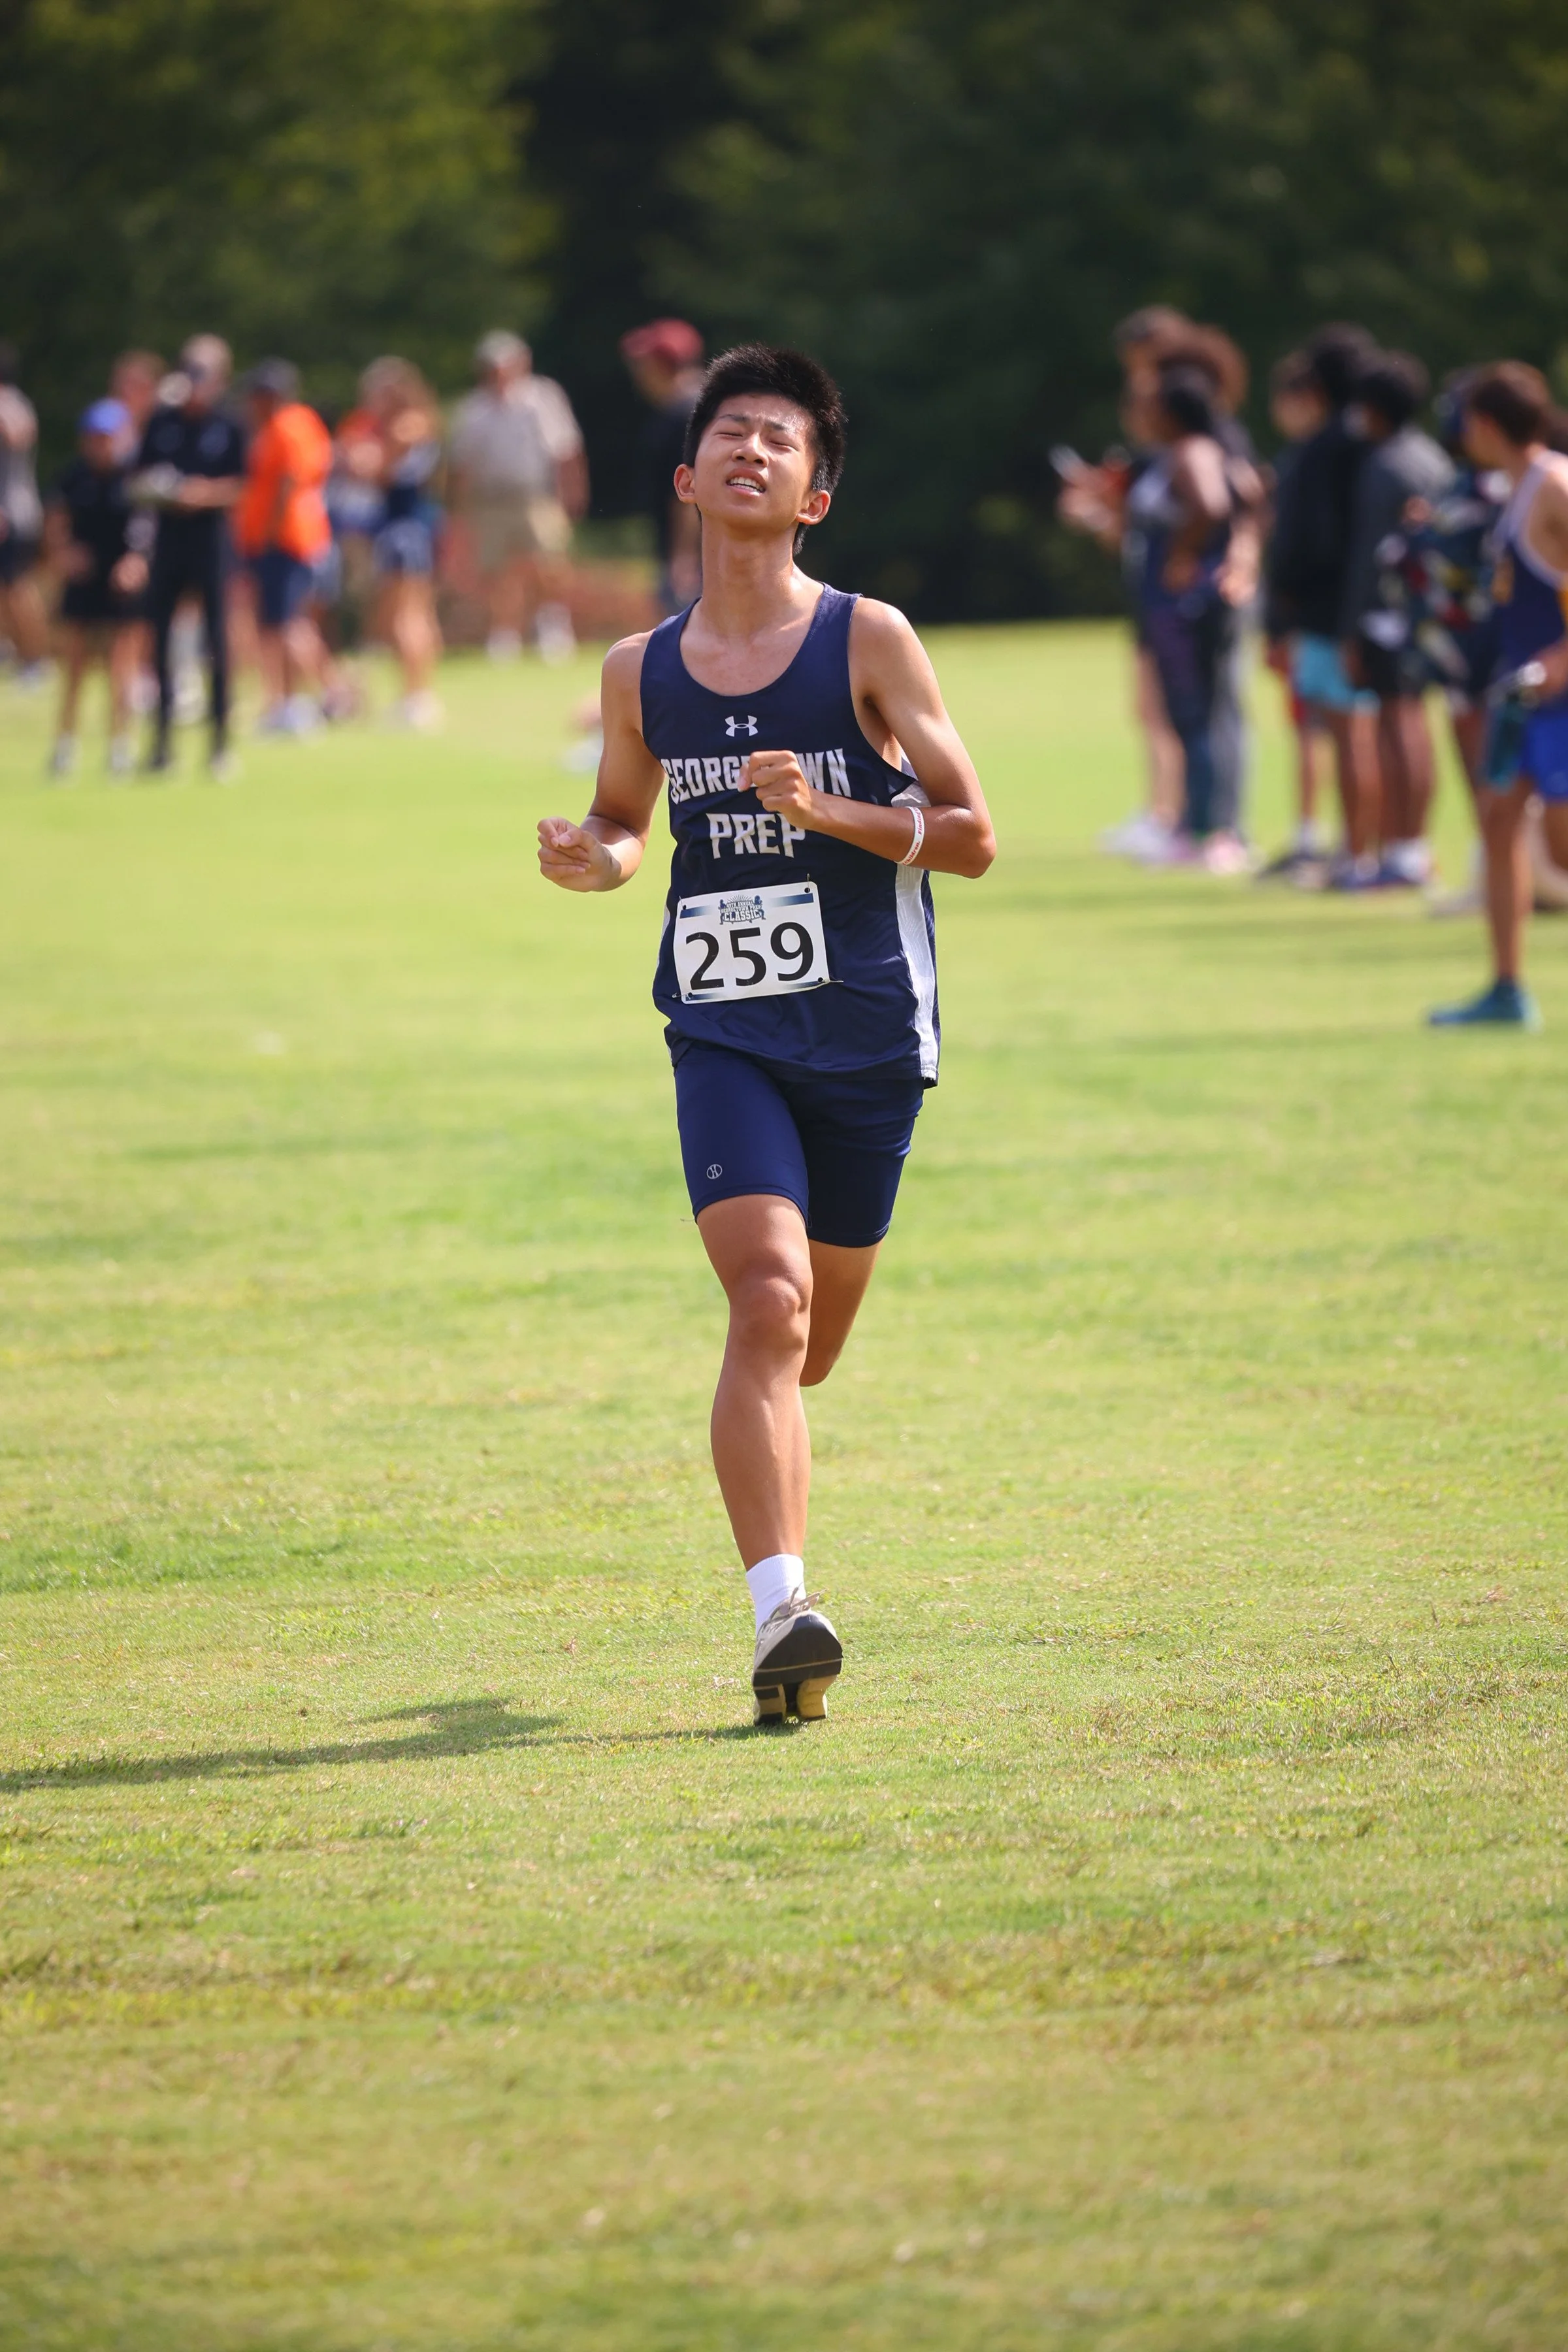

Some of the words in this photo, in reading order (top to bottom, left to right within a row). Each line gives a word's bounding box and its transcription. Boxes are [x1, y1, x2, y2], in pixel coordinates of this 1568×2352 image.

[661, 748, 851, 804] GEORGWN
[706, 813, 806, 859] PREP
[724, 909, 760, 921] CLASSIC
[686, 922, 813, 990] 259
